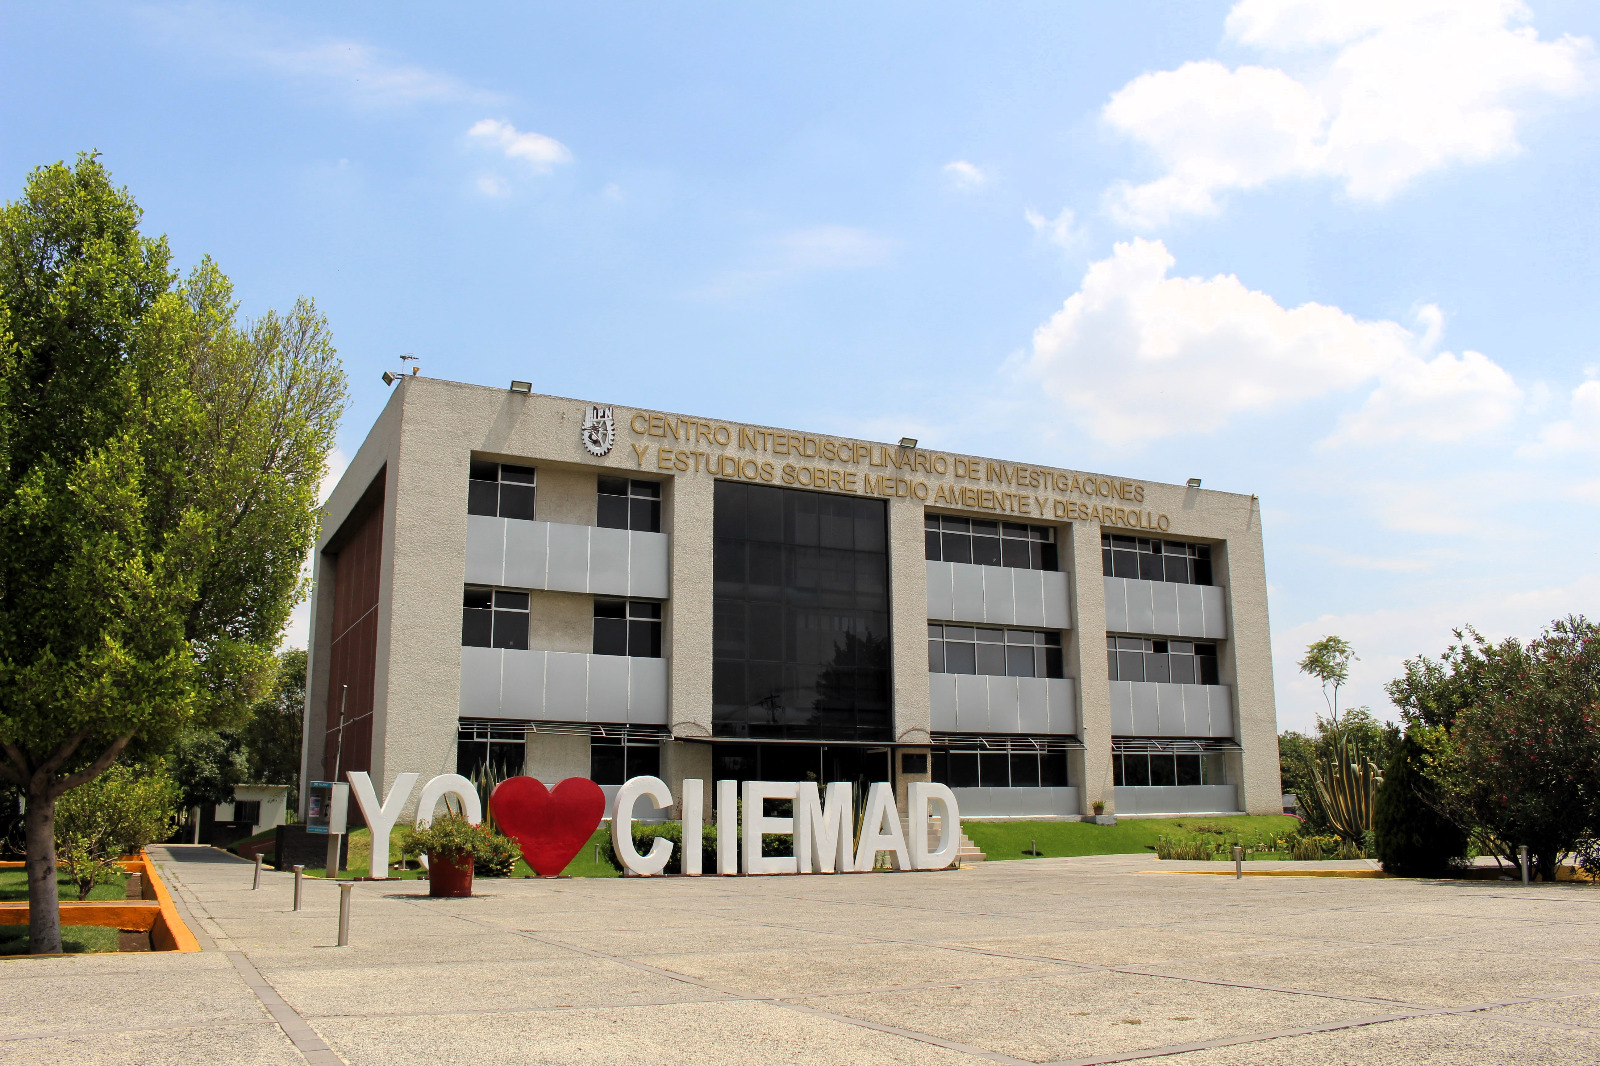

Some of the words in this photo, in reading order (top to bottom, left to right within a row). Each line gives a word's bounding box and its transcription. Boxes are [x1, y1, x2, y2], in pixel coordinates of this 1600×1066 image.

[593, 407, 613, 420] IPN
[631, 413, 732, 445] CENTRO
[739, 427, 949, 475] INTERDISCIPLINARIO
[955, 458, 981, 480] DE
[987, 463, 1145, 502] INVESTIGACIONES
[632, 443, 650, 466] Y
[658, 448, 775, 481] ESTUDIOS
[782, 464, 857, 492] SOBRE
[865, 474, 930, 500] MEDIO
[934, 484, 1031, 514] AMBIENTE
[1034, 496, 1049, 515] Y
[1055, 499, 1170, 531] DESARROLLO
[612, 775, 961, 875] CIIEMAD
